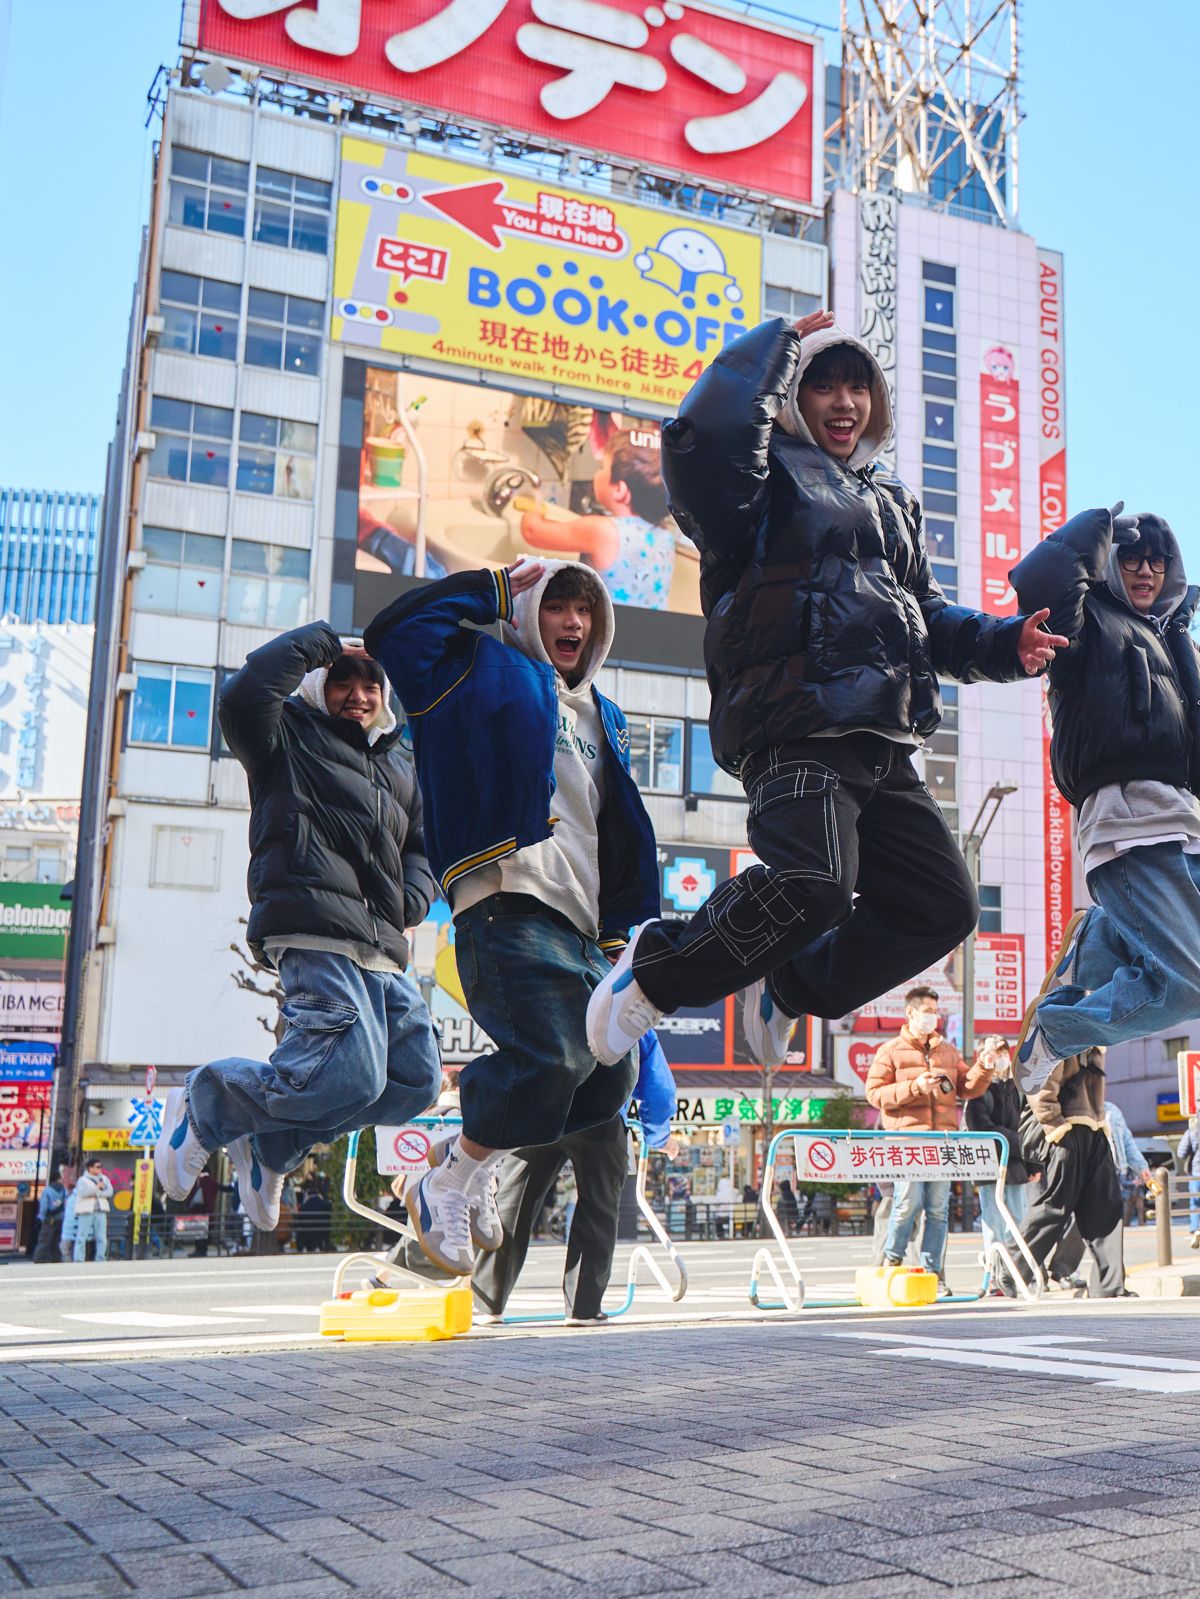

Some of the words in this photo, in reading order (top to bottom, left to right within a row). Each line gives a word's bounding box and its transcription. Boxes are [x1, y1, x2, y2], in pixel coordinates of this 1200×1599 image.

[502, 208, 537, 231] You
[540, 222, 573, 242] are
[574, 227, 617, 251] here
[538, 193, 614, 232] 現在地
[382, 243, 442, 276] ここ!
[1039, 262, 1058, 343] ADULT
[432, 340, 504, 365] 4minute
[509, 356, 545, 375] walk
[552, 364, 591, 385] from
[595, 373, 632, 392] here
[1041, 349, 1060, 440] GOODS
[629, 429, 662, 449] uni
[850, 1145, 991, 1167] 歩行者天国実施中
